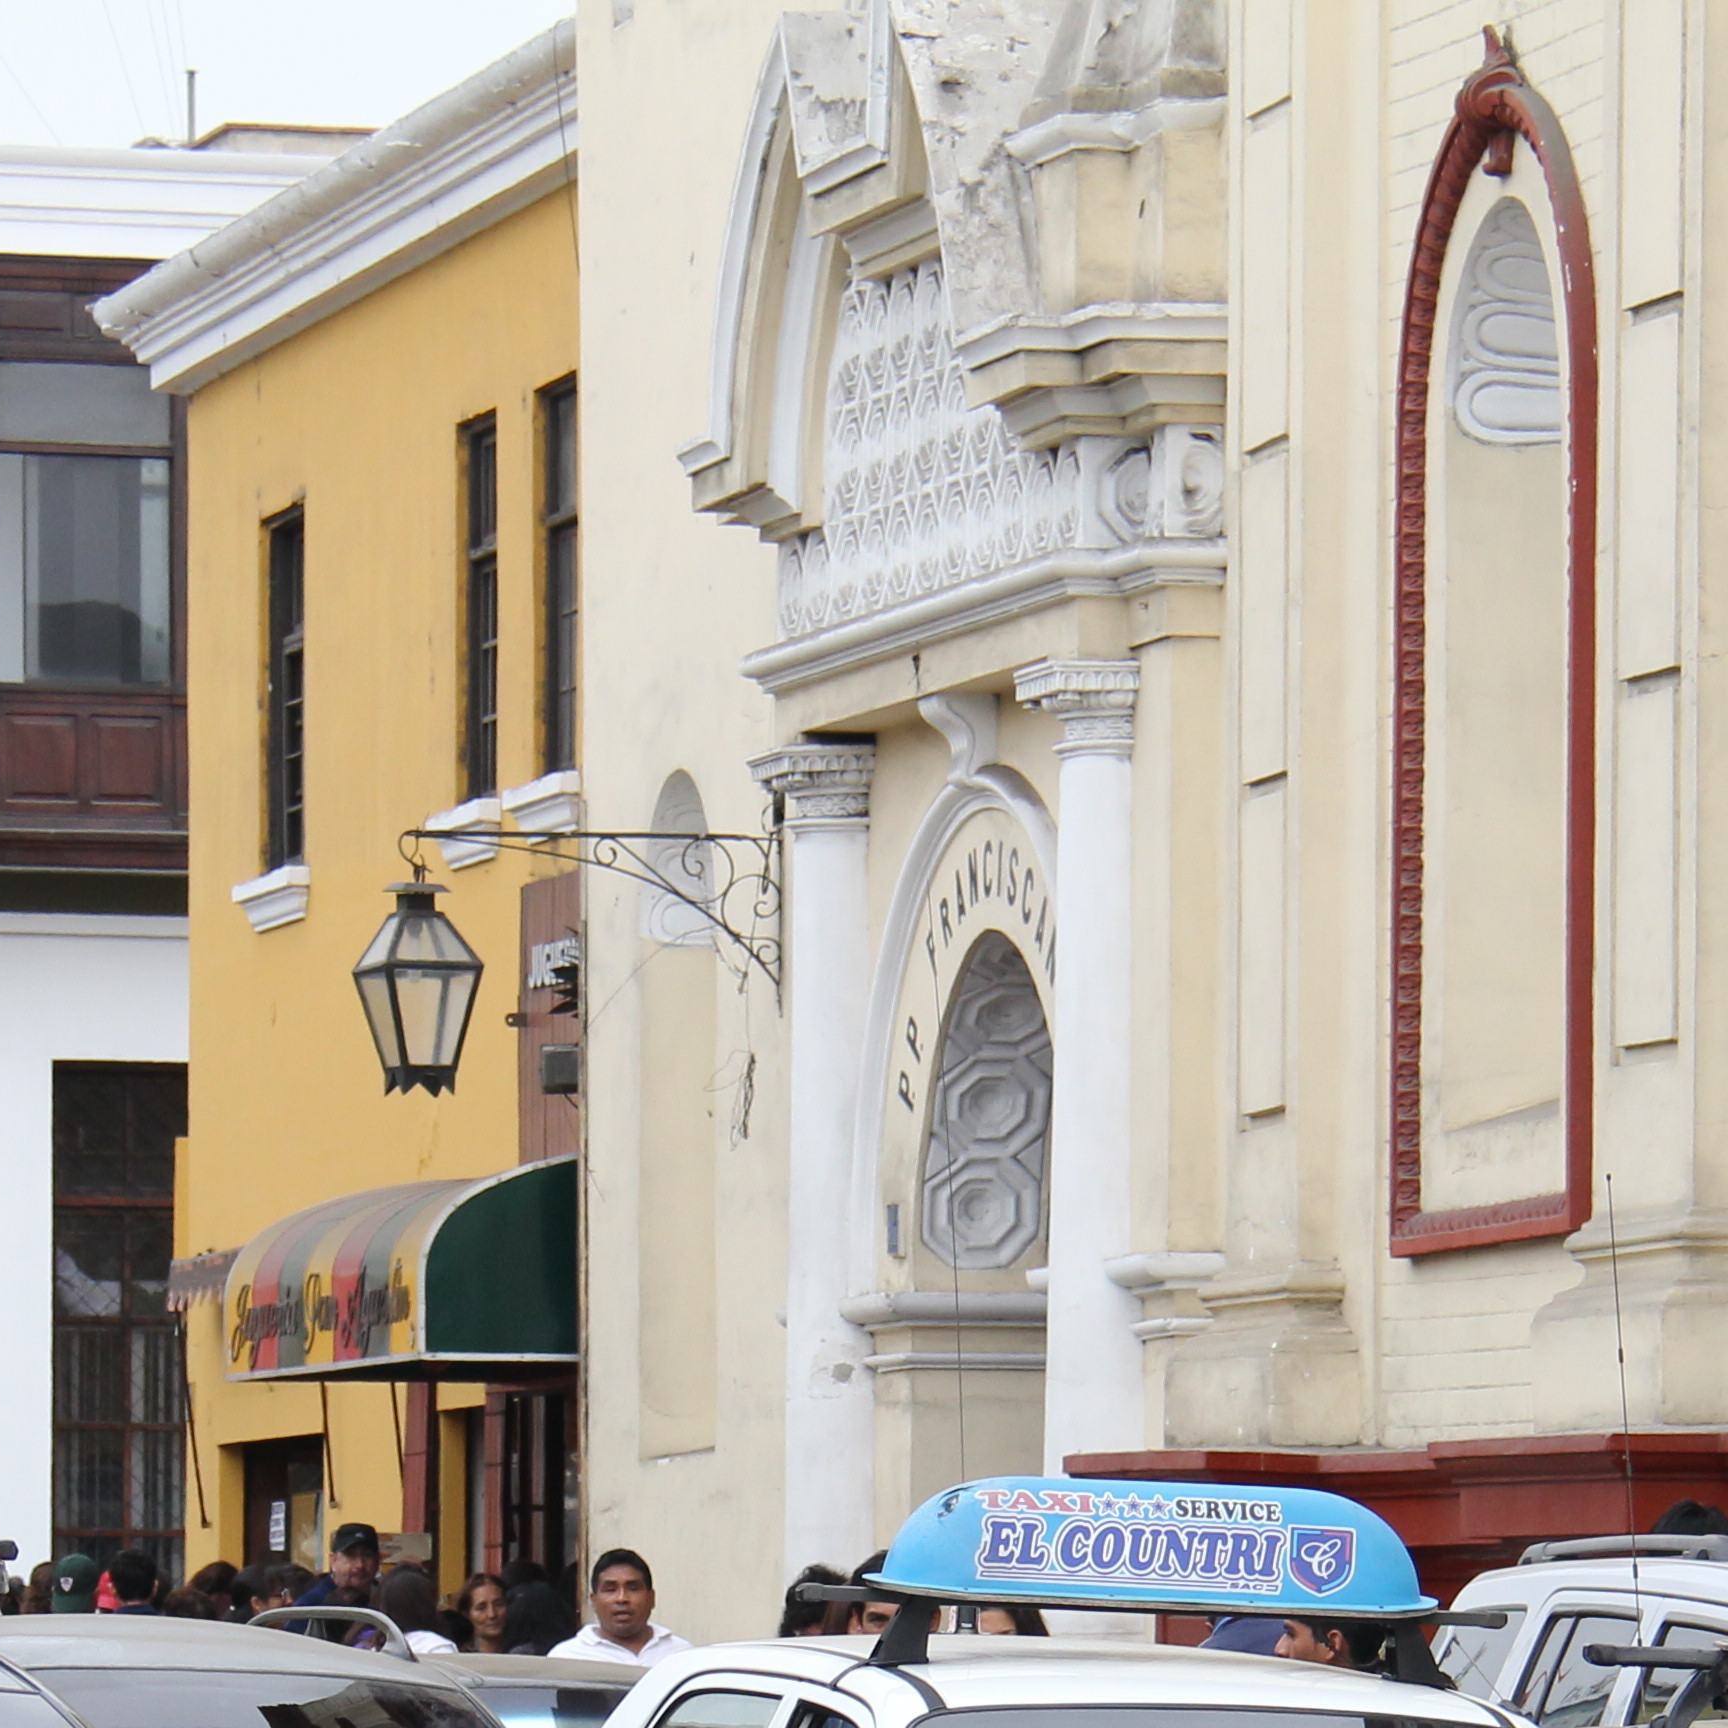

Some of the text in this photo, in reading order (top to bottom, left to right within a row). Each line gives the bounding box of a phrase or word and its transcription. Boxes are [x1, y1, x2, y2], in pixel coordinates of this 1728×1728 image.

[976, 1490, 1282, 1523] TAXI SERVICE
[980, 1517, 1286, 1581] EL COUNTRI
